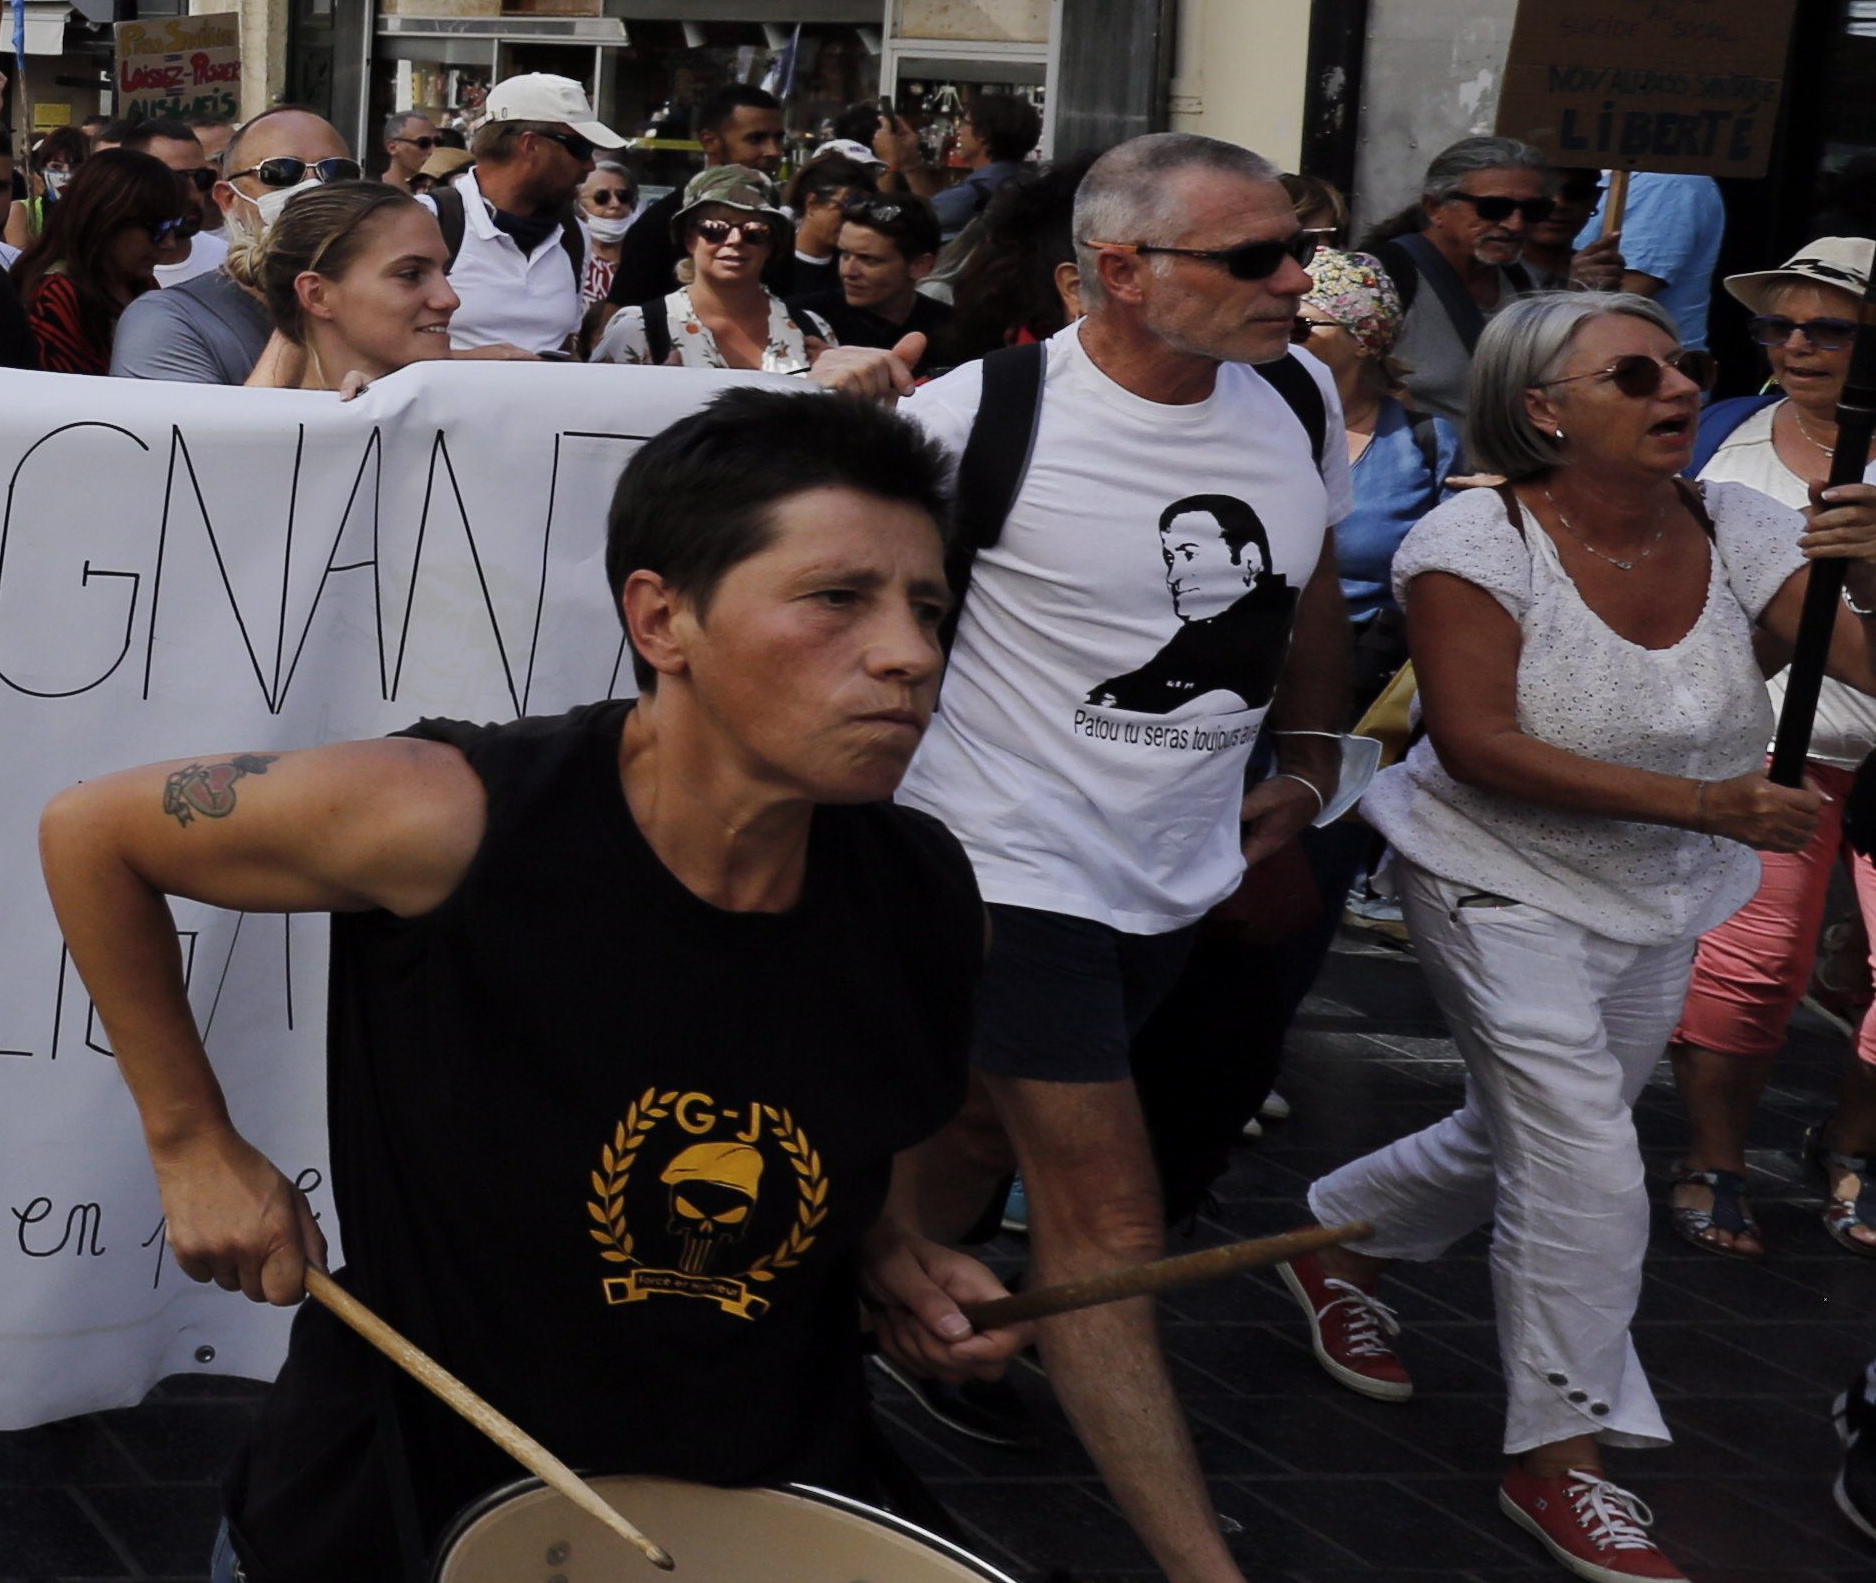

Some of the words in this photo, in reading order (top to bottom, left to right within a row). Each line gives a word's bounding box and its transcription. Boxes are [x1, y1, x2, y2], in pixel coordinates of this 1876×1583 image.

[1073, 708, 1120, 742] Patou
[1123, 721, 1140, 745] tu
[1143, 724, 1189, 751] seras
[1191, 724, 1239, 755] toujours
[675, 1091, 763, 1144] G-J
